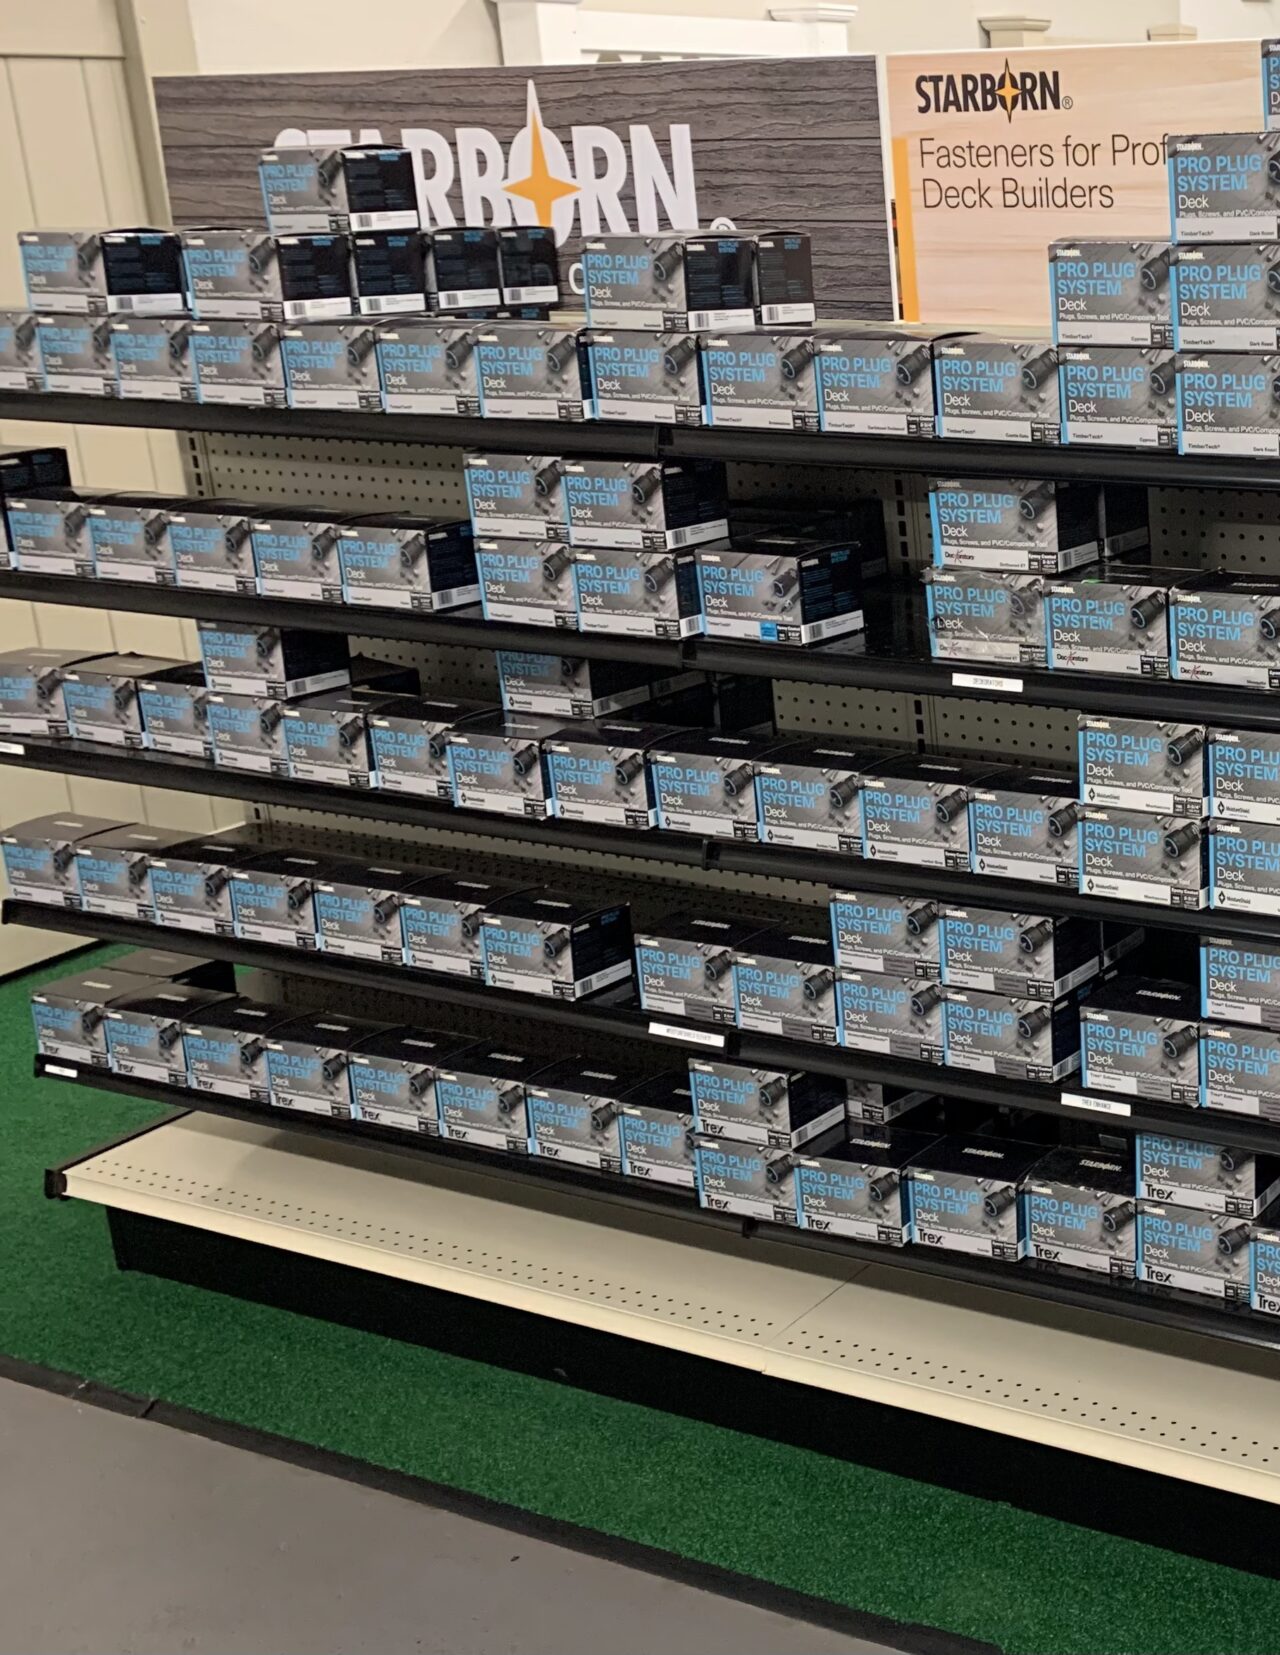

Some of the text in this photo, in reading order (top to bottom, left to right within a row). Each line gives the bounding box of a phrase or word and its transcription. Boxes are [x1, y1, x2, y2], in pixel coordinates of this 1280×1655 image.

[920, 137, 1053, 168] Fasteners
[1061, 135, 1100, 168] for
[922, 178, 1114, 209] Deck Builders
[587, 255, 649, 270] PRO PLUG
[588, 269, 639, 285] SYSTEM
[590, 285, 612, 299] Deck
[471, 469, 530, 485] PRO PLUG
[472, 484, 522, 498] SYSTEM
[474, 498, 496, 510] Deck
[939, 493, 1015, 508] PRO PLUG
[940, 509, 1001, 523] SYSTEM
[942, 524, 968, 537] Deck
[1087, 732, 1162, 752] PRO PLUG
[452, 745, 510, 765] PRO PLUG
[1087, 748, 1149, 767] SYSTEM
[454, 760, 501, 776] SYSTEM
[1087, 764, 1114, 778] Deck
[456, 773, 478, 785] Deck
[485, 926, 540, 945] PRO PLUG
[486, 941, 532, 956] SYSTEM
[488, 952, 507, 966] Deck
[696, 1074, 755, 1093] PRO PLUG
[698, 1087, 746, 1104] SYSTEM
[699, 1099, 720, 1112] Deck
[701, 1119, 724, 1134] Trex
